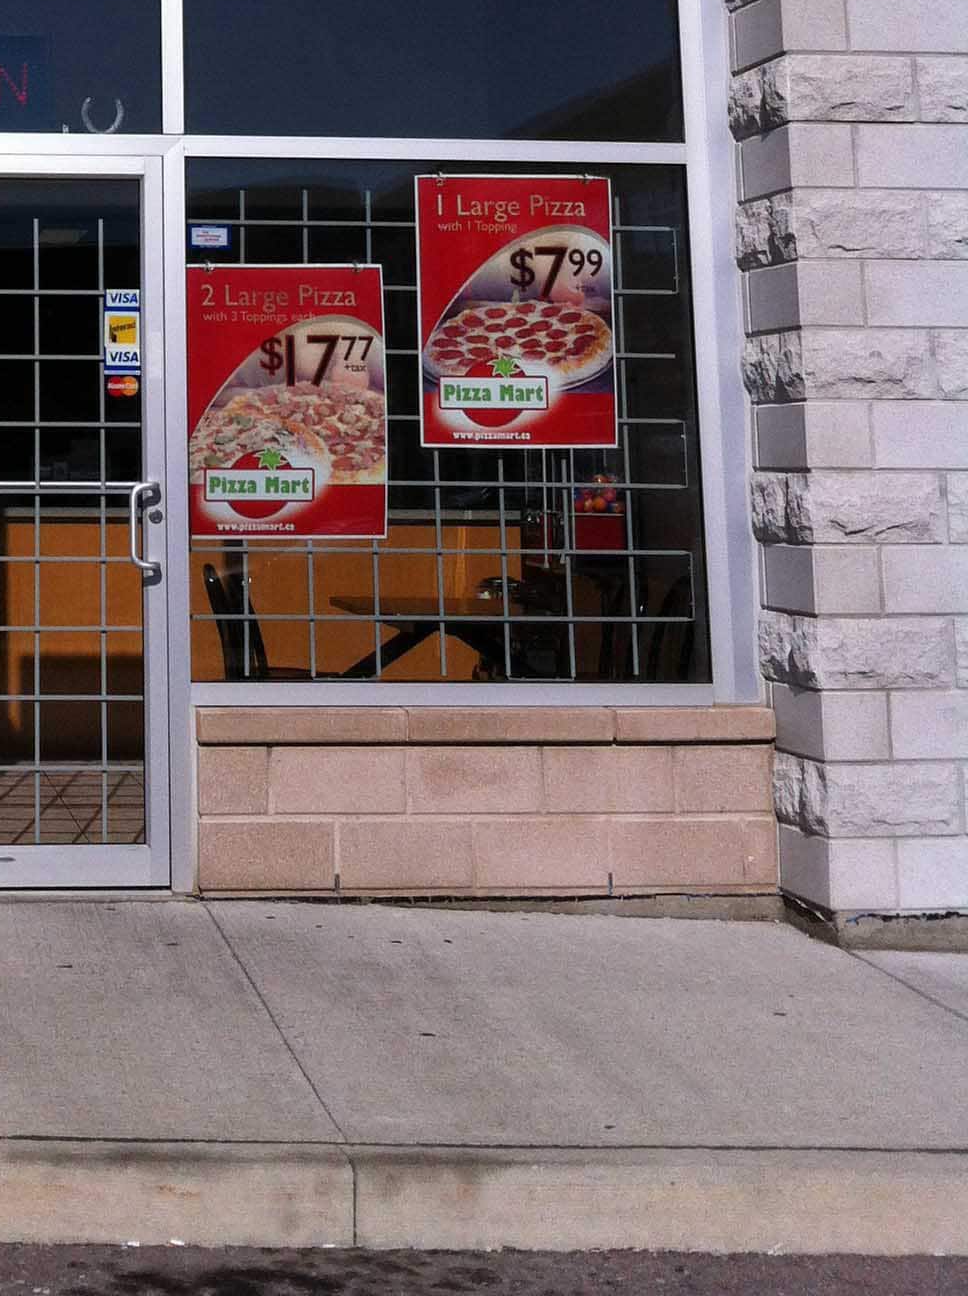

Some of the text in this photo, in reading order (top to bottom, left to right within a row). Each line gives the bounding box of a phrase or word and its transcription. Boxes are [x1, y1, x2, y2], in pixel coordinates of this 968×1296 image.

[436, 193, 587, 222] 1 Large Pizza
[438, 222, 463, 232] with
[475, 220, 518, 235] Topping
[110, 292, 138, 304] VISA
[200, 283, 357, 313] 2 Large Pizza
[202, 312, 228, 322] with
[242, 311, 289, 326] Toppings
[109, 351, 139, 363] VISA
[443, 384, 544, 402] Pizza Mart
[452, 431, 531, 441] www.pizzamart.ca
[209, 475, 310, 494] Pizza Mart
[216, 522, 295, 533] www.pizzamart.ca
